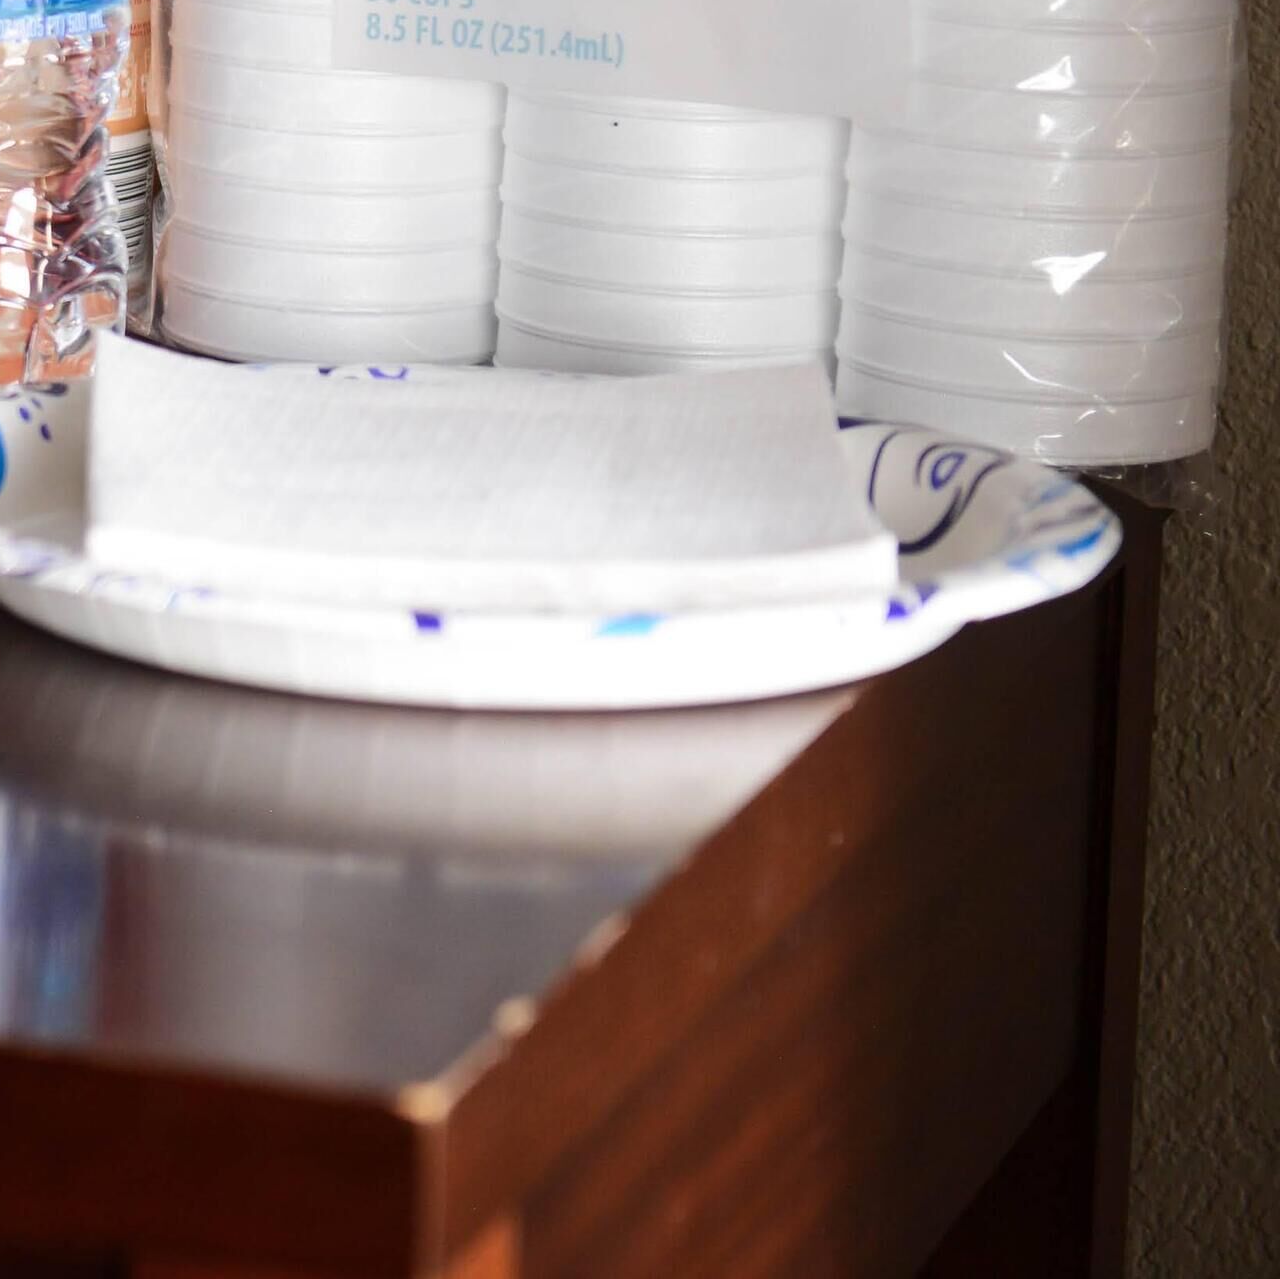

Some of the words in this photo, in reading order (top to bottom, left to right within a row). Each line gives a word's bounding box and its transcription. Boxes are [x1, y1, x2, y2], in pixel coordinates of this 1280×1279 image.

[365, 14, 407, 43] 8.5
[415, 16, 445, 46] FL
[451, 20, 484, 51] OZ
[490, 21, 625, 68] (251.4mL)
